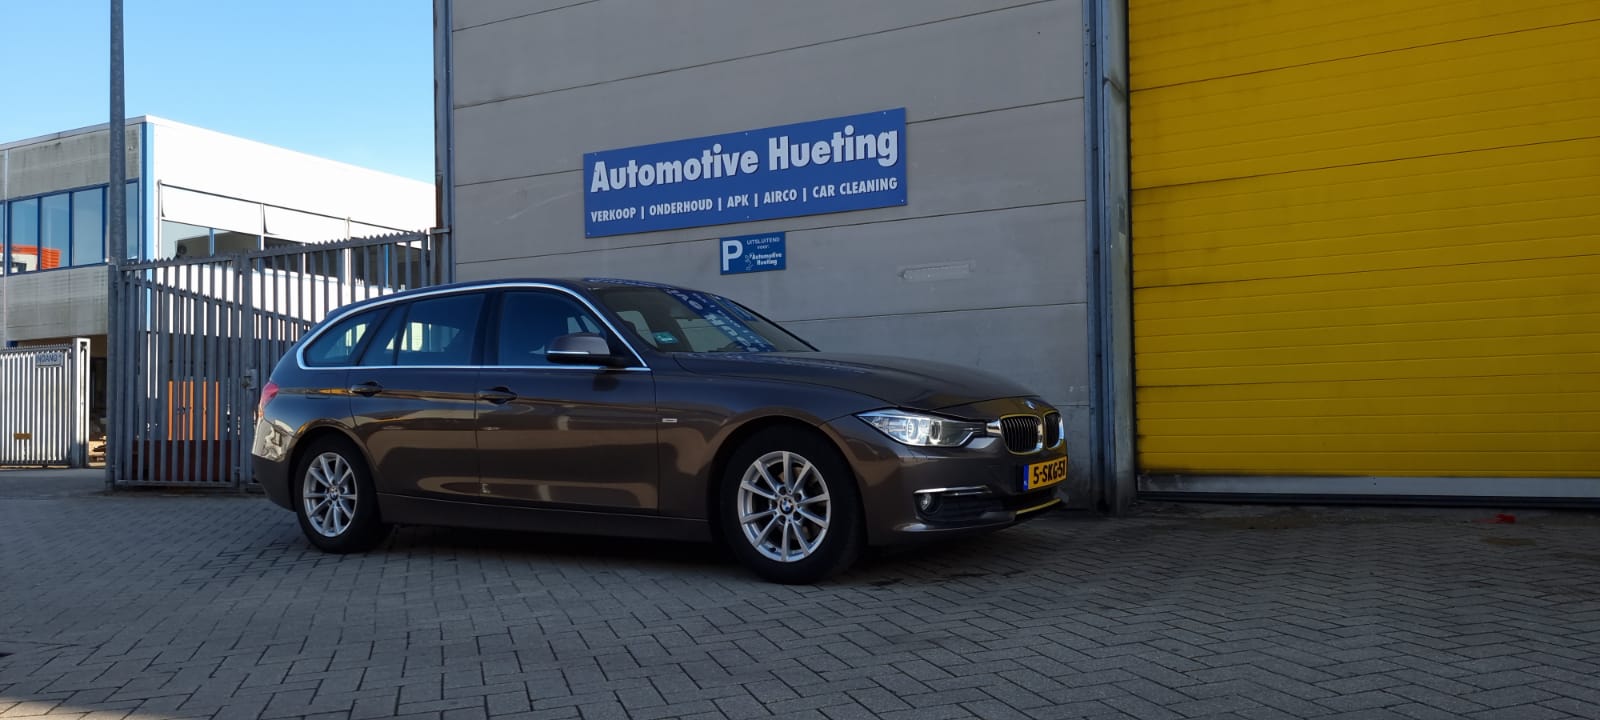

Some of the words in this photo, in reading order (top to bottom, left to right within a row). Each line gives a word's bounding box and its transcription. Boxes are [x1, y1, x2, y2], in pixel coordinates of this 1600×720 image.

[591, 143, 759, 193] Automotive
[769, 125, 898, 167] Hueting
[591, 206, 637, 223] VERKOOP
[650, 198, 713, 216] ONDERHOUD
[727, 194, 749, 208] APK
[764, 189, 798, 204] AIRCO
[813, 184, 836, 199] CAR
[840, 177, 898, 195] CLEANING
[722, 240, 743, 271] P
[752, 252, 782, 260] Automotive
